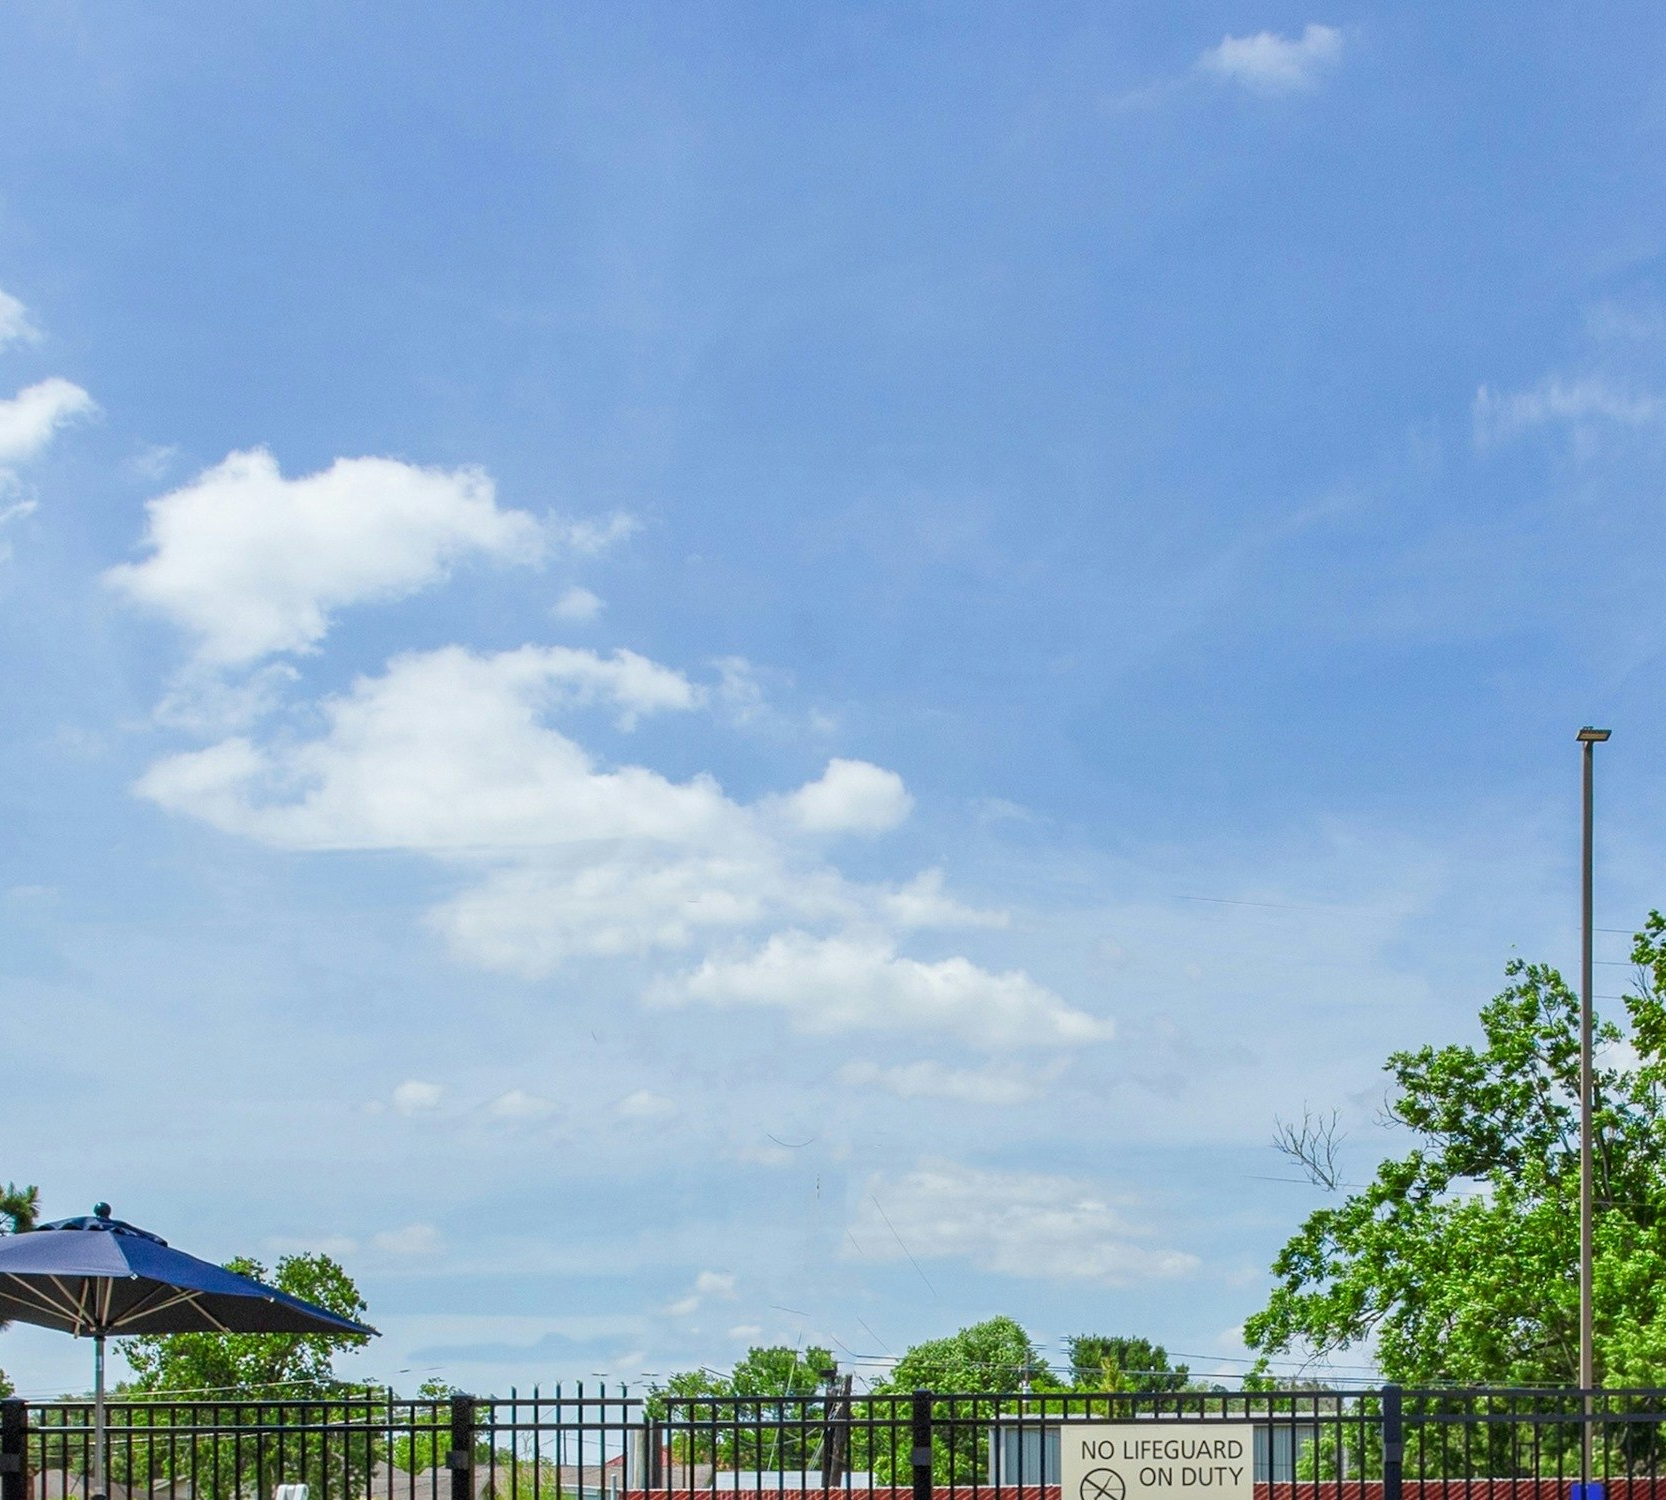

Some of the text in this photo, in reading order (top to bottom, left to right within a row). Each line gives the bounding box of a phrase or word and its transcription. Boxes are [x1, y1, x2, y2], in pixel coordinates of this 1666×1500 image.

[1081, 1440, 1243, 1460] NO LIFEGUARD
[1139, 1467, 1244, 1486] ON DUTY
